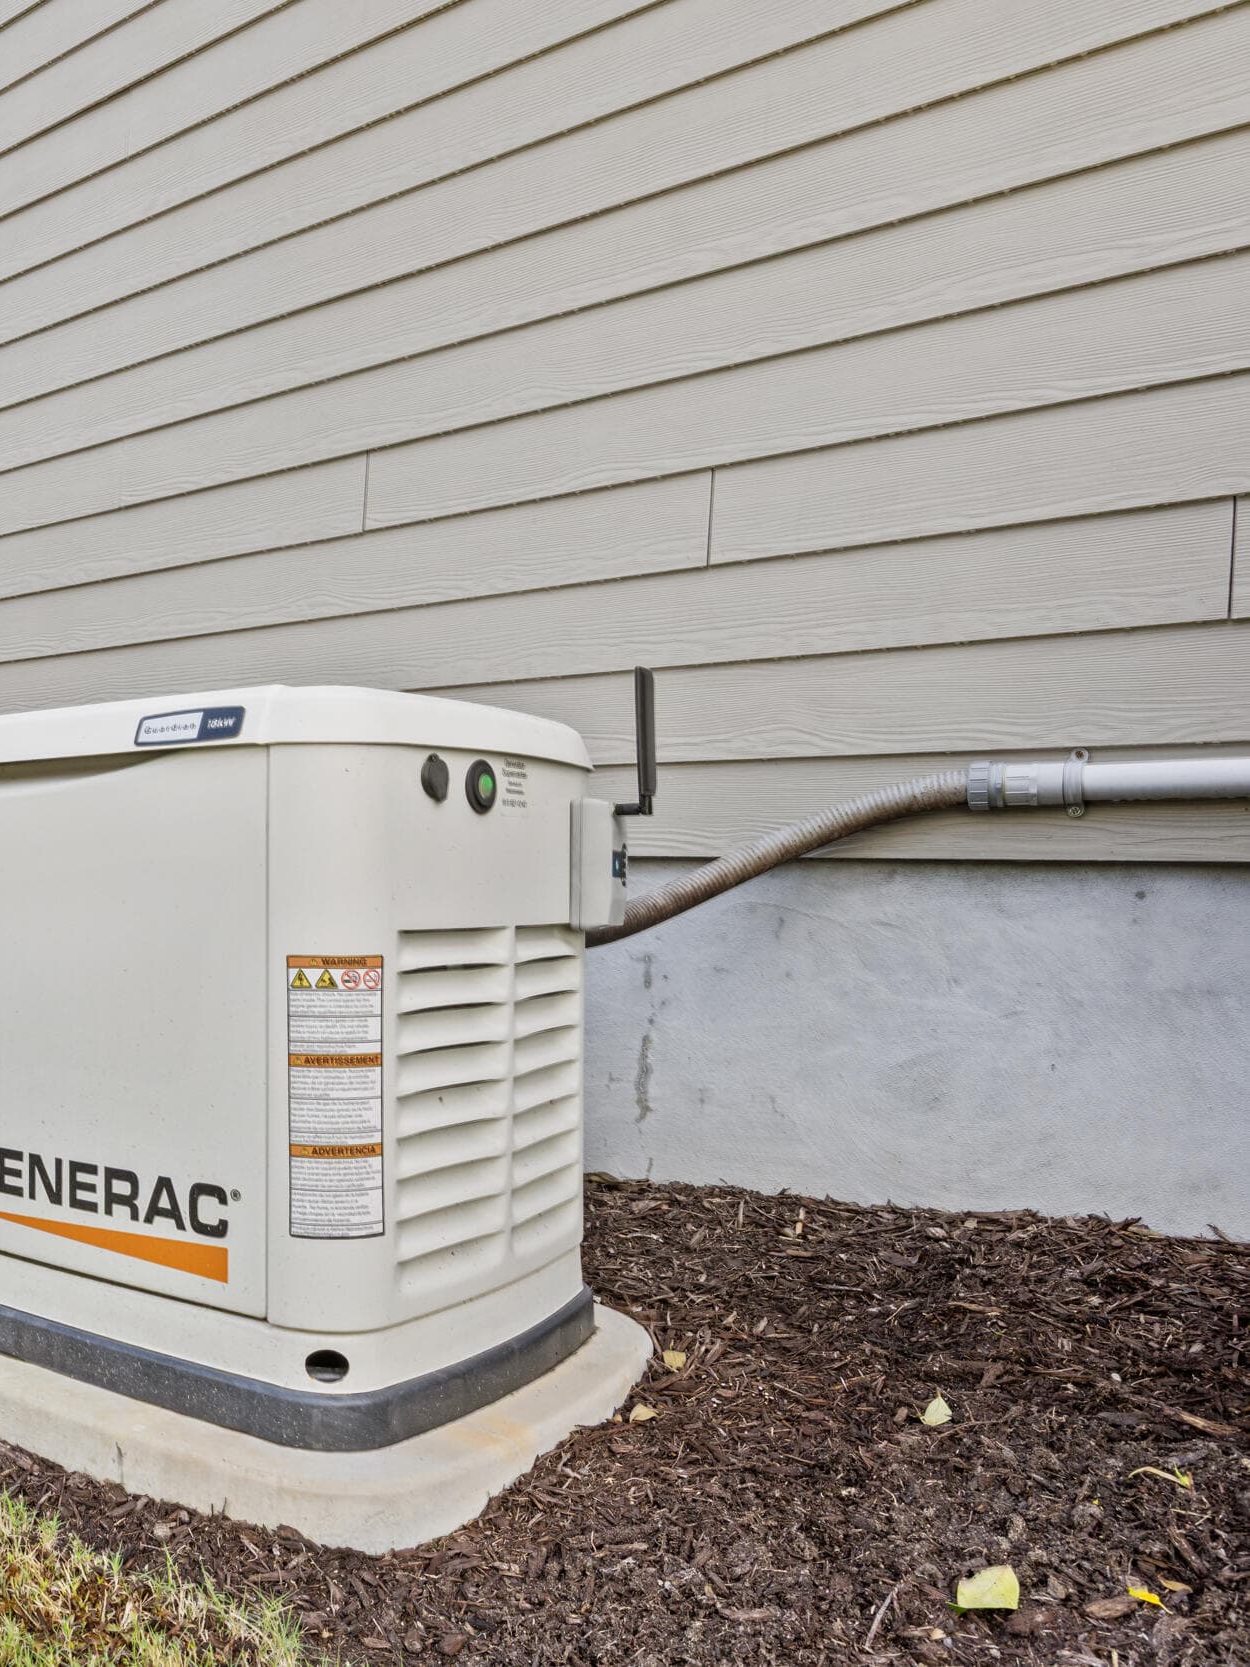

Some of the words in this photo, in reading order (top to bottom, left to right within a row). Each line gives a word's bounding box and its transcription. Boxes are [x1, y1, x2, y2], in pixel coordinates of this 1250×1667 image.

[321, 957, 367, 966] WARNING
[304, 1056, 379, 1065] AVERTISSEMENT
[311, 1145, 377, 1155] ADVERTENCIA
